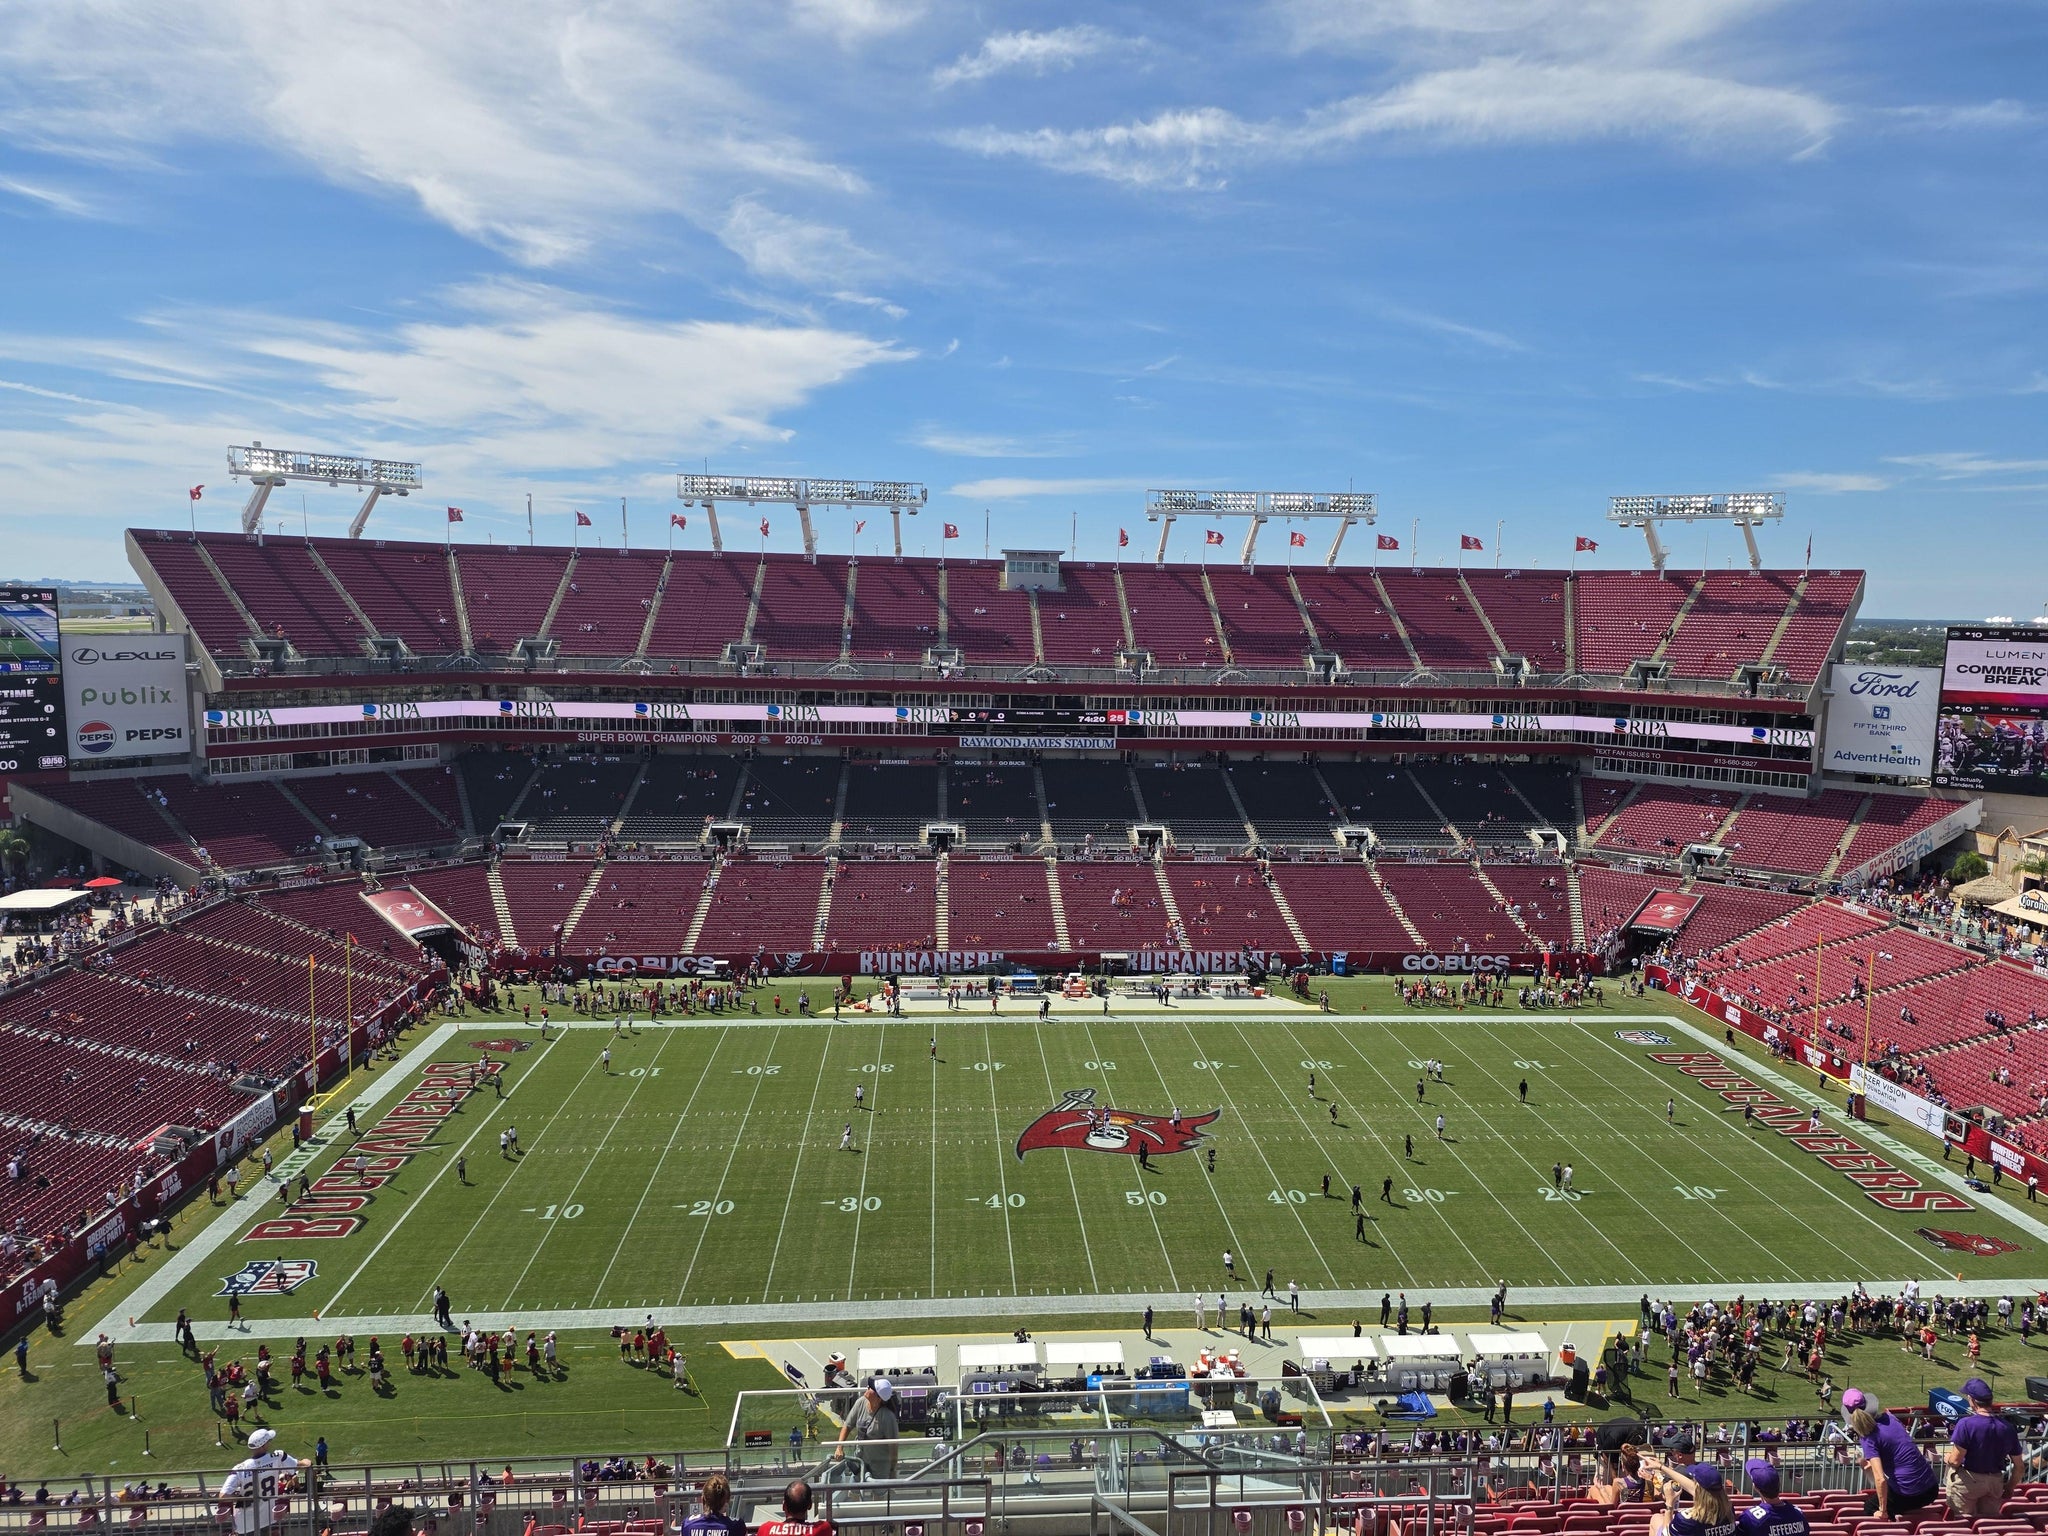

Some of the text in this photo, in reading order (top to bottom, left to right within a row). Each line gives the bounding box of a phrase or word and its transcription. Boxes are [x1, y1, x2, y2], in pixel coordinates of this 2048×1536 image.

[102, 651, 176, 660] LEXUS
[1986, 650, 2043, 660] LUMEN
[1850, 671, 1920, 698] Ford
[1984, 675, 2042, 686] BREAK
[81, 686, 172, 706] Publix
[378, 703, 422, 719] RIPA
[515, 701, 556, 718] RIPA
[651, 704, 690, 719] RIPA
[782, 706, 822, 721] RIPA
[911, 708, 948, 723] RIPA
[227, 710, 275, 727] RIPA
[1142, 711, 1178, 726] RIPA
[1264, 713, 1299, 727] RIPA
[1386, 714, 1421, 728] RIPA
[1505, 715, 1541, 730] RIPA
[46, 727, 56, 737] 9
[126, 728, 182, 741] PEPSI
[1629, 721, 1668, 737] RIPA
[79, 733, 114, 742] PEPSI
[577, 733, 717, 743] SUPER BOWL CHAMPIONS
[731, 735, 755, 744] 2002
[785, 736, 809, 744] 2020
[961, 737, 1115, 749] RAYMOND JAMES STADIUM
[1769, 730, 1814, 747] RIPA
[42, 757, 62, 765] 50/50
[1834, 750, 1921, 766] AdventHealth
[453, 939, 488, 958] TAMPA
[596, 956, 714, 974] GO BUCS
[1403, 955, 1510, 972] GO BUCS
[1882, 1081, 1907, 1100] VISION
[1647, 1051, 1976, 1213] BUCCANEERS
[236, 1062, 506, 1246] BUCCANEERS
[1879, 1140, 1913, 1156] OF
[1910, 1157, 1946, 1174] US
[1990, 1140, 2025, 1166] WINFIELD'S
[1992, 1154, 2022, 1175] WINNERS
[1125, 1191, 1167, 1206] 50
[1267, 1189, 1307, 1204] 40
[1403, 1188, 1445, 1202] 30
[1537, 1187, 1581, 1201] 20
[1673, 1185, 1716, 1200] 10
[689, 1200, 735, 1216] 20
[840, 1197, 881, 1212] 30
[985, 1193, 1025, 1208] 40
[538, 1204, 584, 1220] 10
[107, 1222, 126, 1247] PARTY
[1941, 1404, 1953, 1415] FOX
[928, 1427, 951, 1438] 334
[769, 1524, 815, 1536] ALSTOTT
[1769, 1521, 1805, 1536] JEFFERSON
